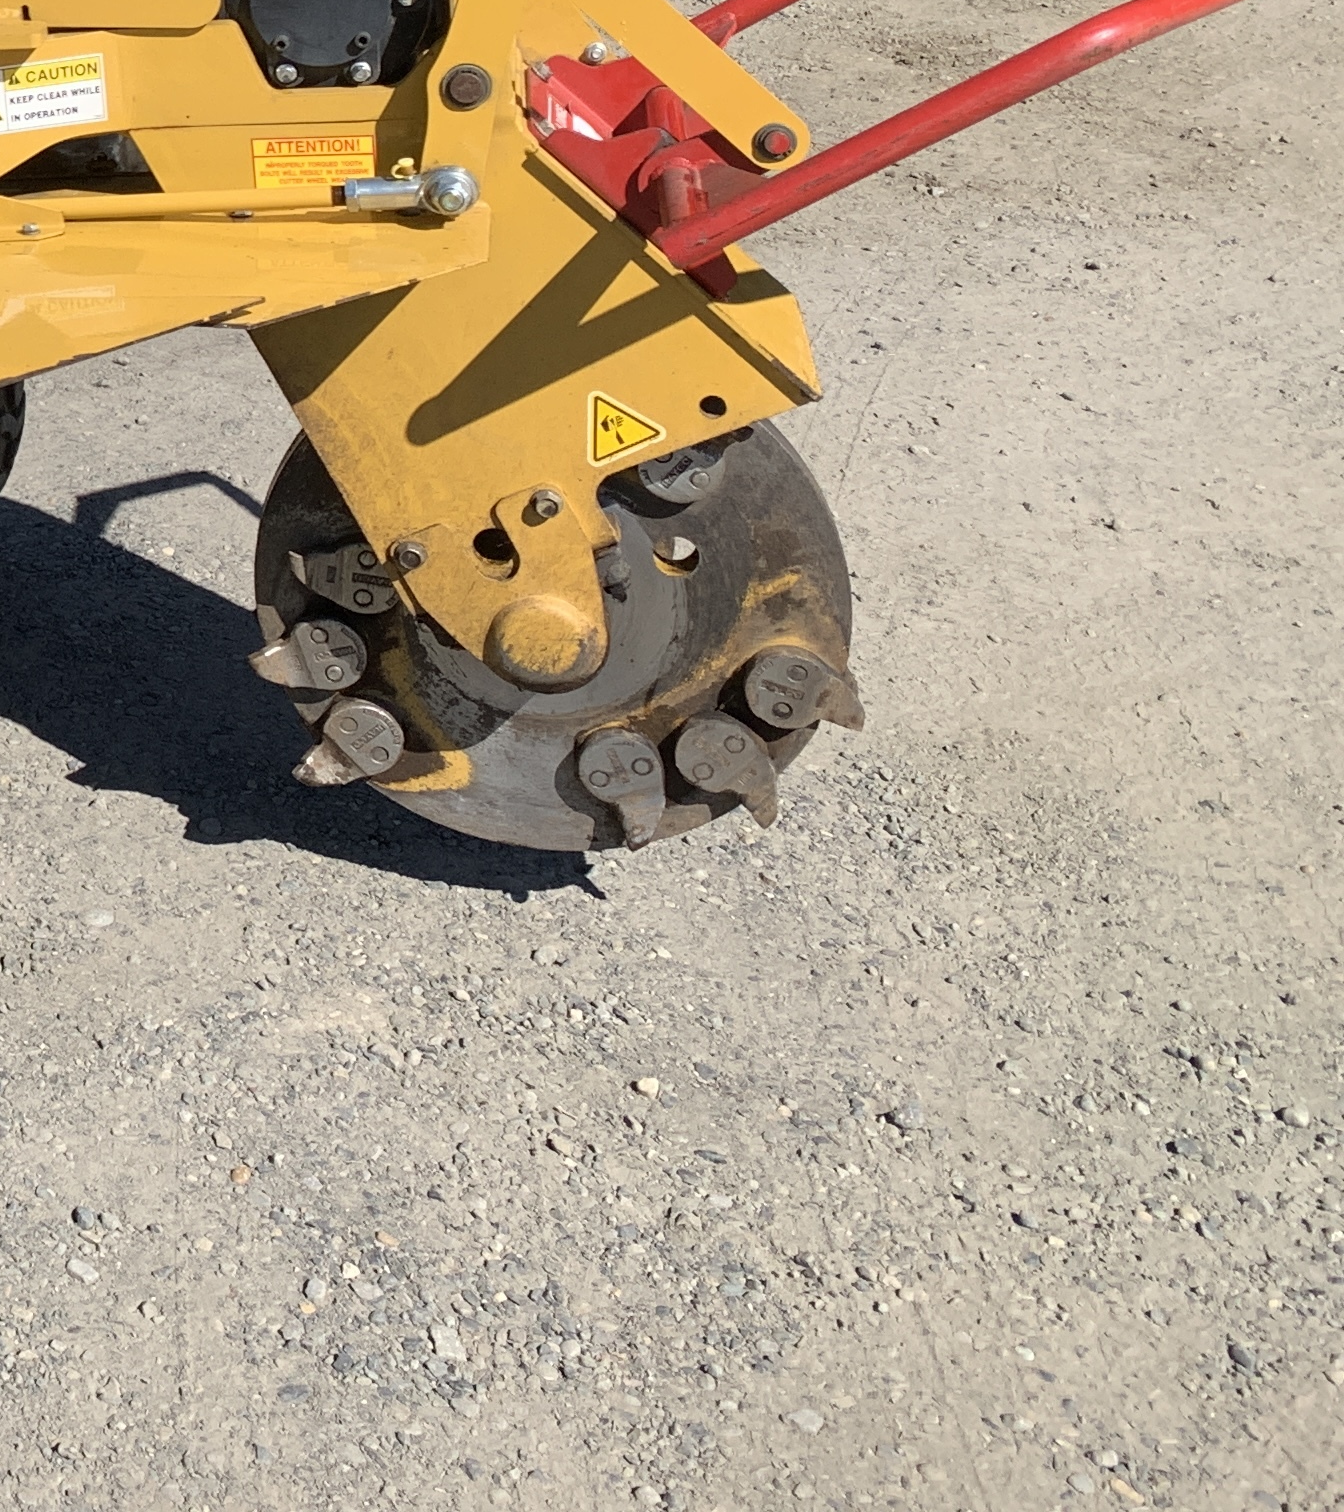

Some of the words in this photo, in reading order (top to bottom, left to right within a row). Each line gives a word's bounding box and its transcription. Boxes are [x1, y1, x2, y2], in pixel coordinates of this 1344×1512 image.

[25, 62, 98, 83] CAUTION
[9, 94, 34, 105] KEEP
[37, 90, 68, 101] CLEAR
[70, 86, 101, 96] WHILE
[10, 113, 21, 122] IN
[25, 107, 79, 121] OPERATION
[265, 139, 360, 154] ATTENTION!
